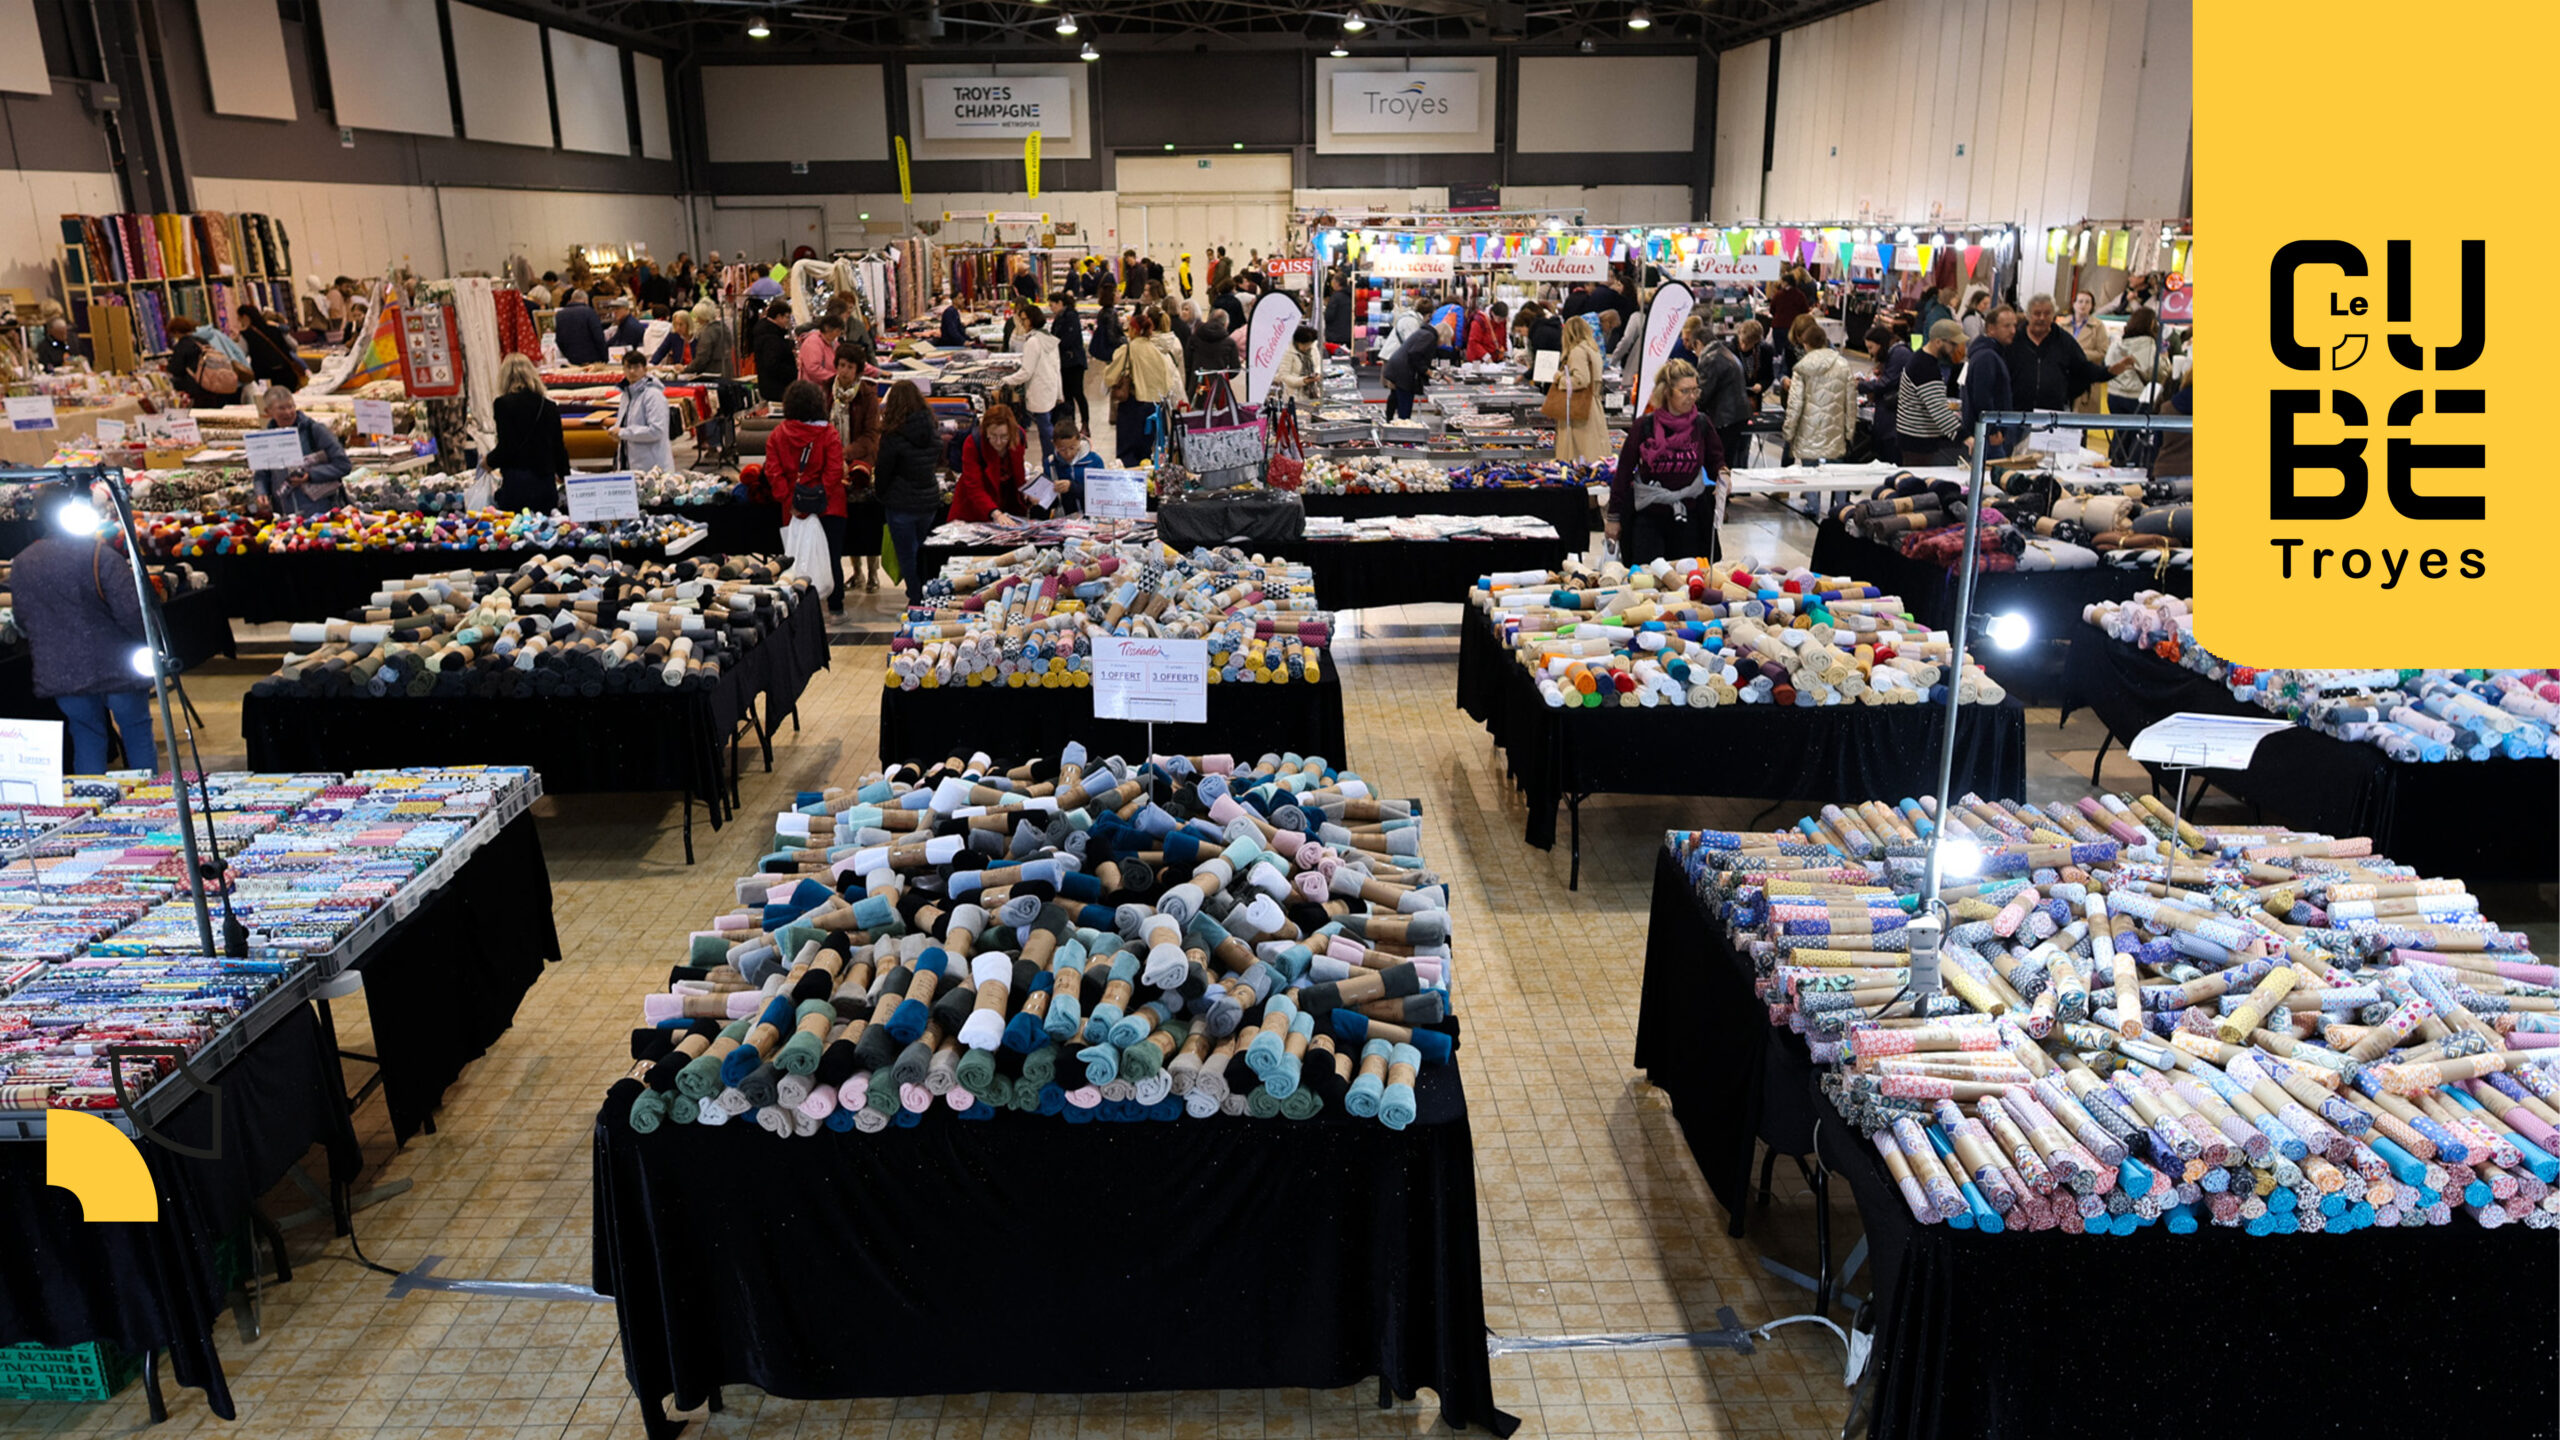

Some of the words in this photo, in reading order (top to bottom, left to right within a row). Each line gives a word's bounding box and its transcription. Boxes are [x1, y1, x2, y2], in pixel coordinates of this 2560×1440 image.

[953, 86, 1012, 101] TROYES
[954, 104, 1040, 118] CHAMPAGNE
[1363, 91, 1449, 122] Troyes
[1528, 257, 1596, 275] Rubans
[1699, 256, 1759, 275] Perles
[1108, 671, 1141, 680] OFFERT
[1160, 672, 1200, 681] OFFERTS
